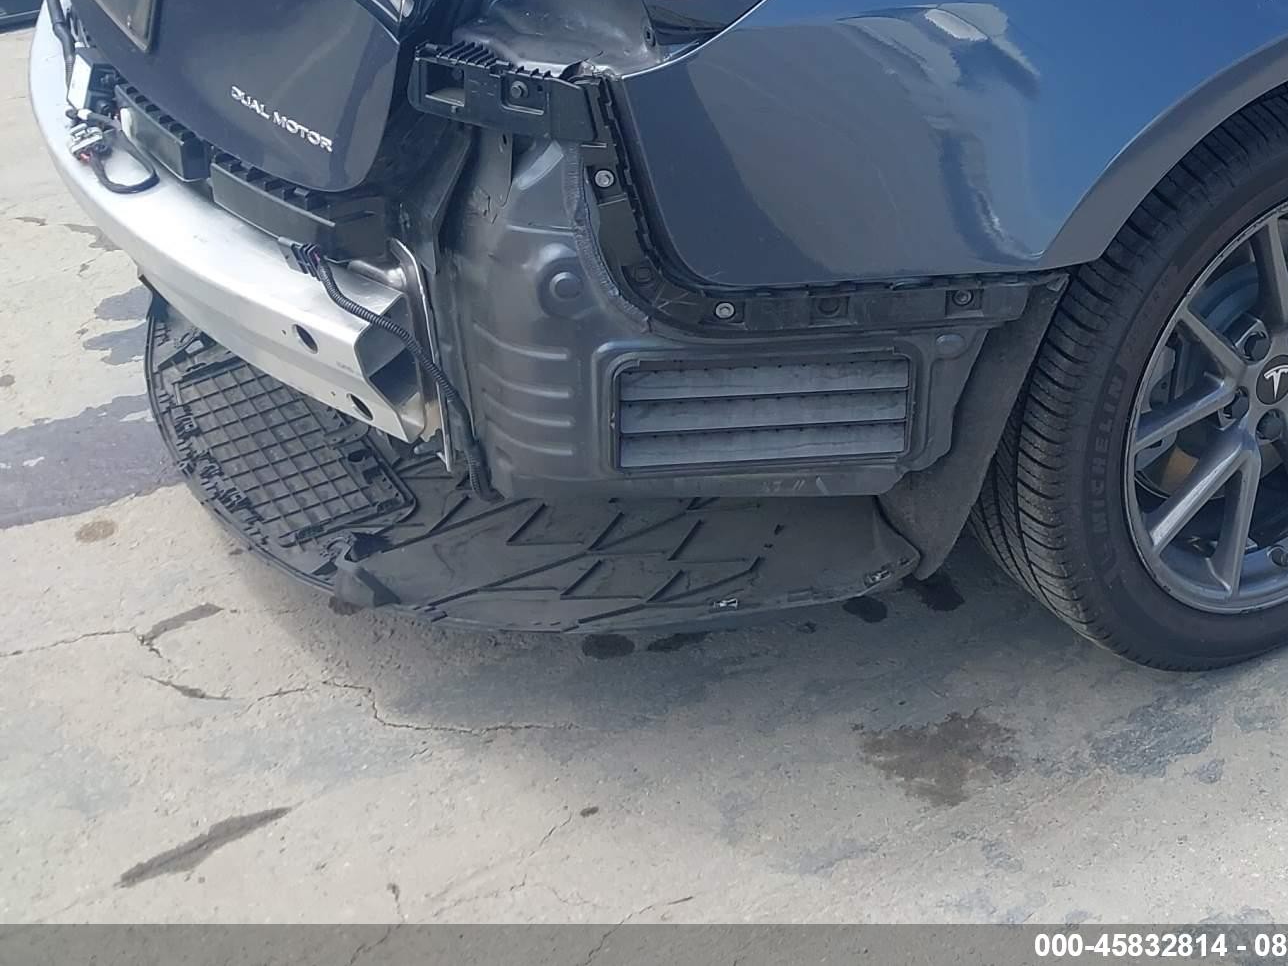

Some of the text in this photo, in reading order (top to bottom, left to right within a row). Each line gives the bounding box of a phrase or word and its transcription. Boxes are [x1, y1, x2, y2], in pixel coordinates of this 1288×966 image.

[231, 86, 333, 153] DUAL MOTOR
[1091, 375, 1123, 534] MICHELIN
